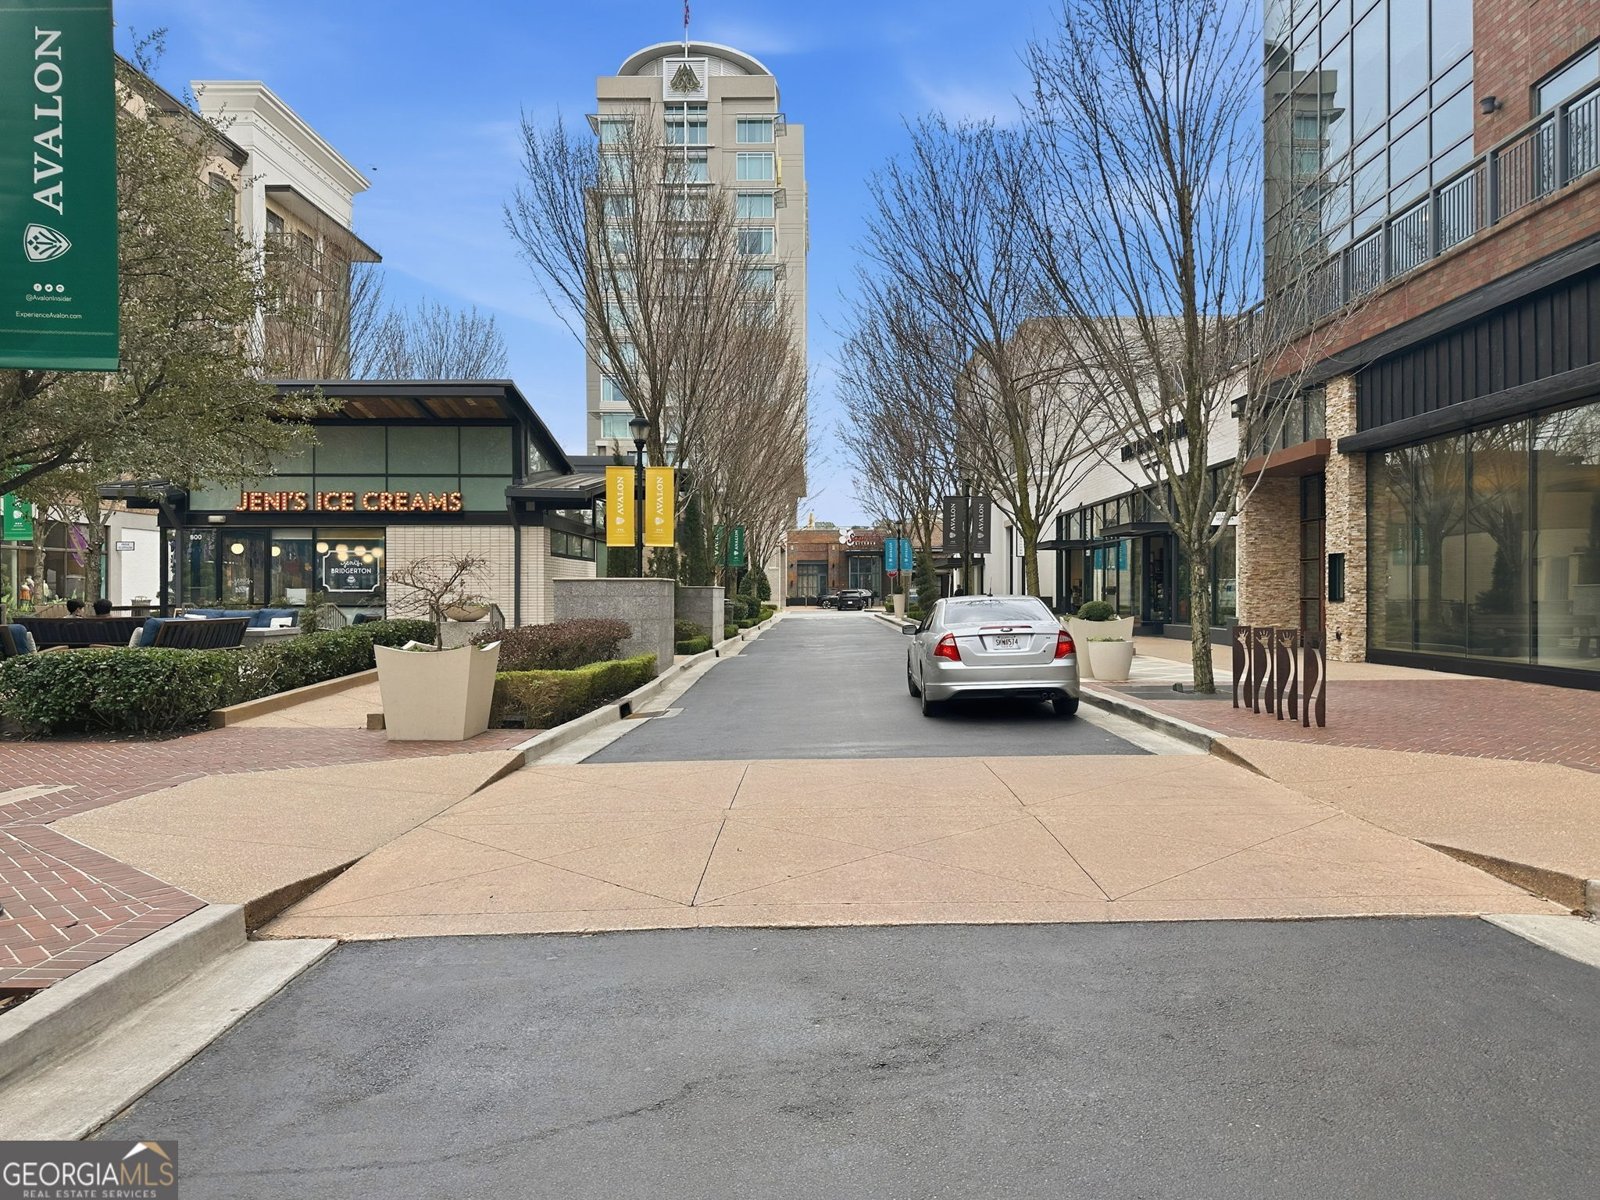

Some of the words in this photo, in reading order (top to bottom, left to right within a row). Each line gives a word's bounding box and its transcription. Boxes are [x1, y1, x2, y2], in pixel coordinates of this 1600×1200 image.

[33, 26, 64, 215] AVALON
[25, 293, 72, 302] @AvalonInsider
[15, 310, 82, 319] ExperienceAvalon.com
[236, 491, 308, 512] JENI'S
[316, 491, 354, 512] ICE
[362, 491, 463, 512] CREAMS
